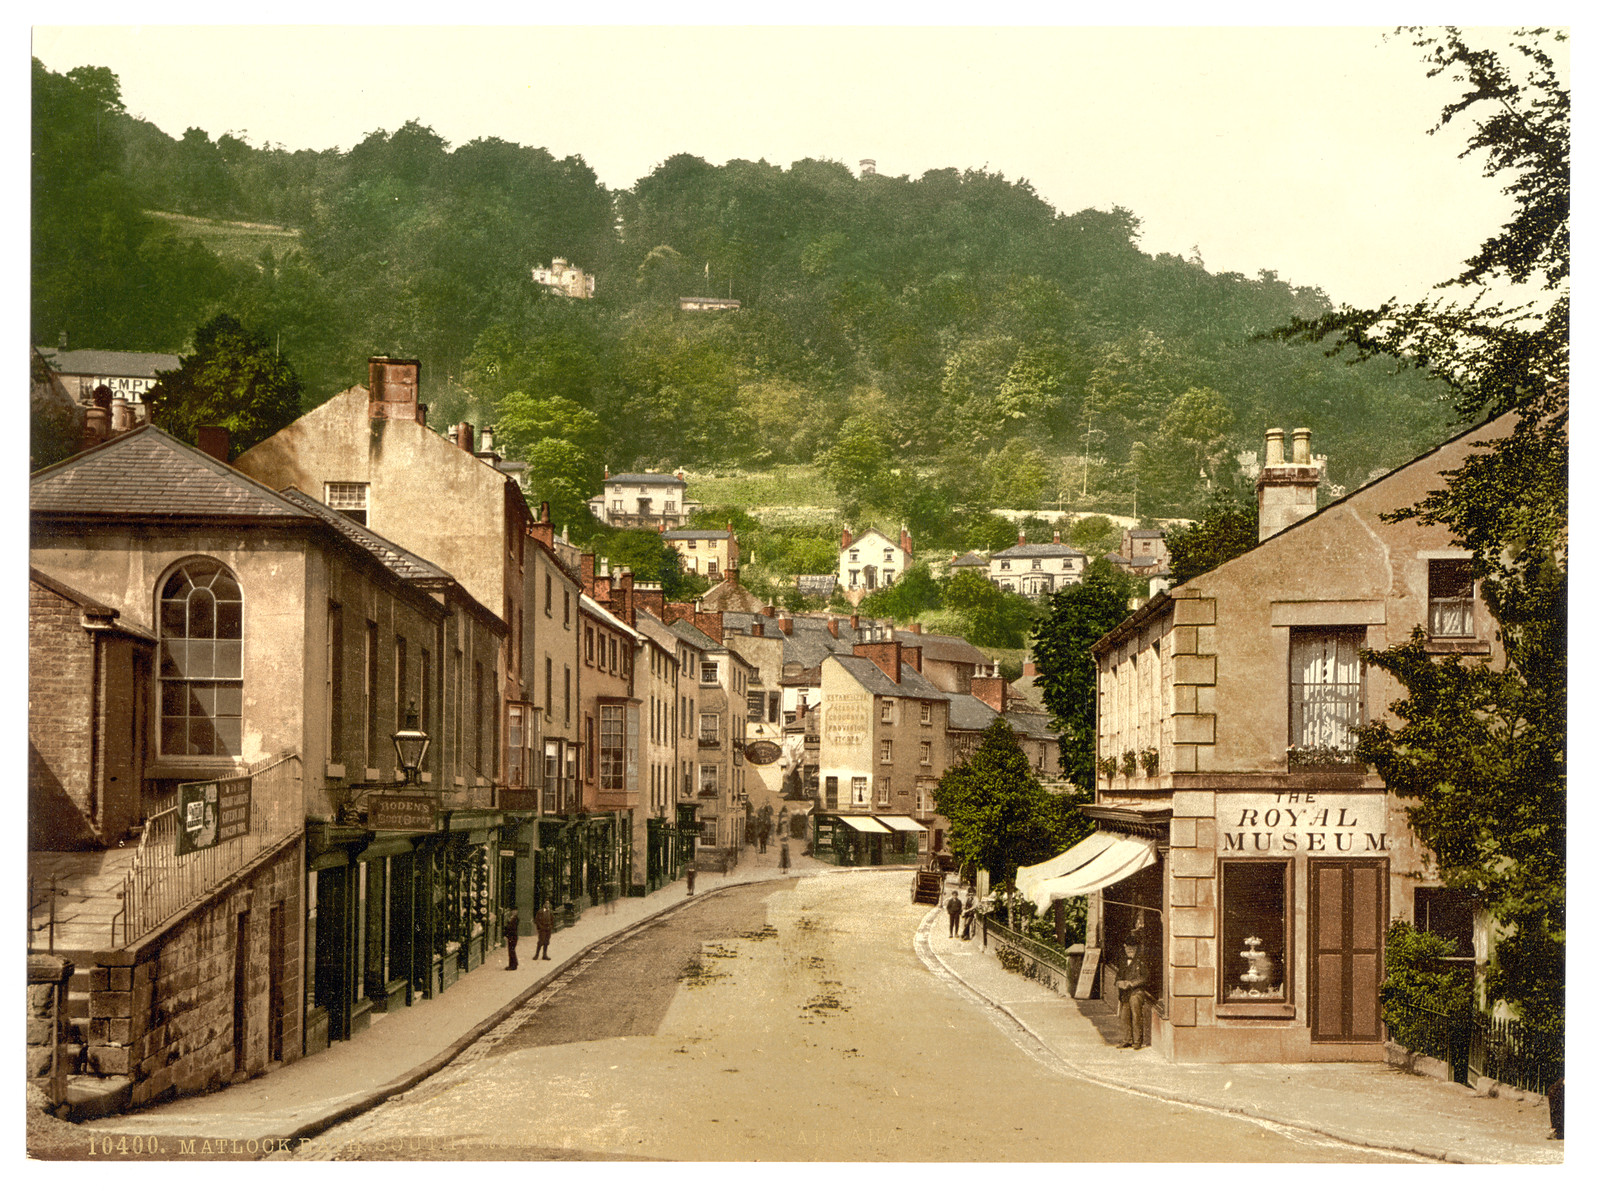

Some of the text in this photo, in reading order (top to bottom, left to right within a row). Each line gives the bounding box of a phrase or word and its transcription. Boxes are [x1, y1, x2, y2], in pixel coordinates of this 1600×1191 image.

[1275, 792, 1317, 804] THE
[1237, 808, 1359, 828] ROYAL
[1222, 832, 1388, 851] MUSEUM
